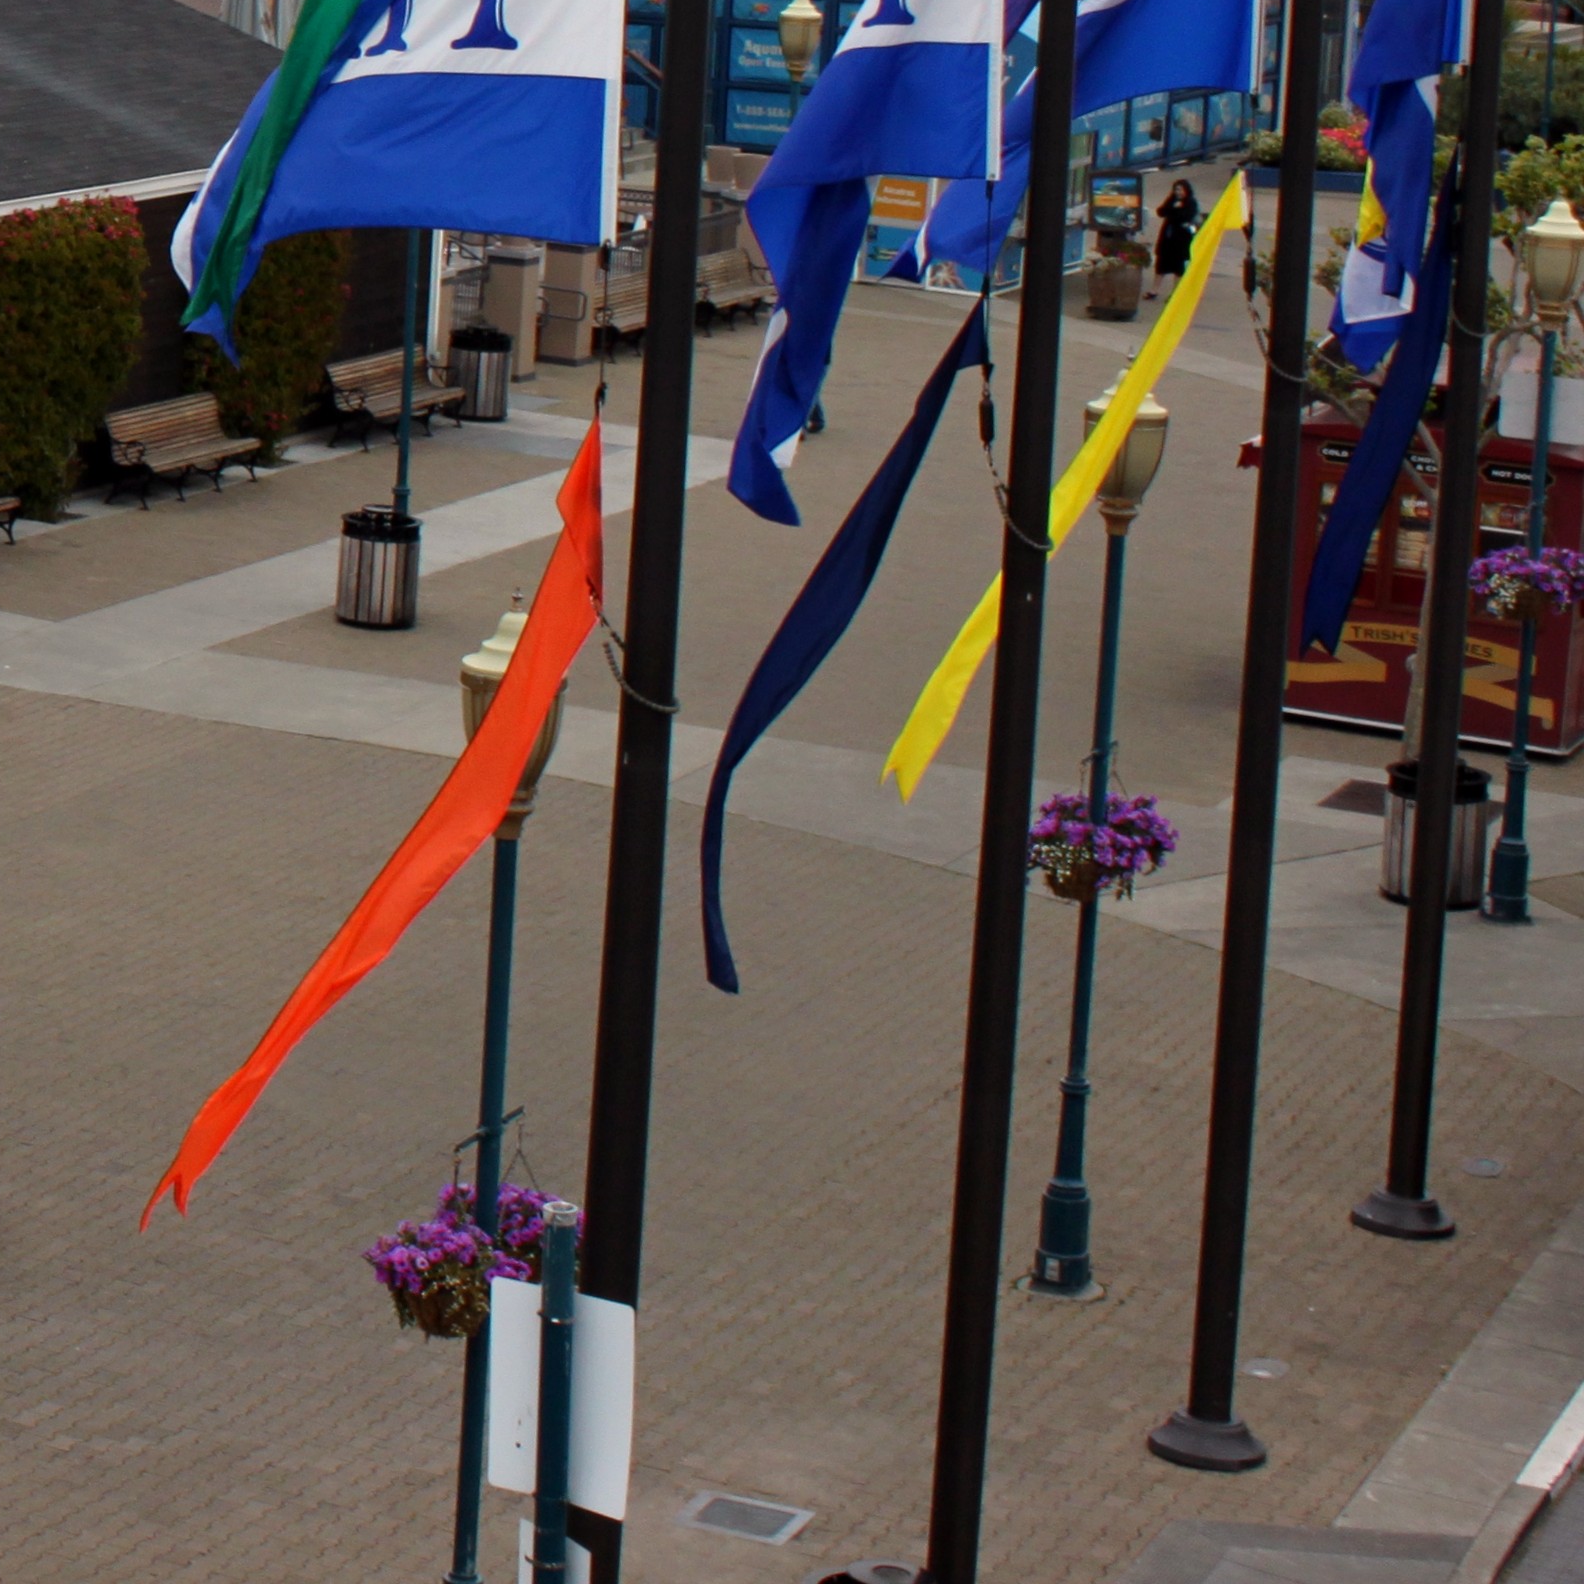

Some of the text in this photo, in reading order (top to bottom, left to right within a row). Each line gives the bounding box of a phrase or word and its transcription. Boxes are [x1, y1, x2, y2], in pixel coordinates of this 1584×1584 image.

[1321, 447, 1349, 458] COLD
[1491, 469, 1534, 482] HOT DOG
[1351, 624, 1418, 645] TRISH'S
